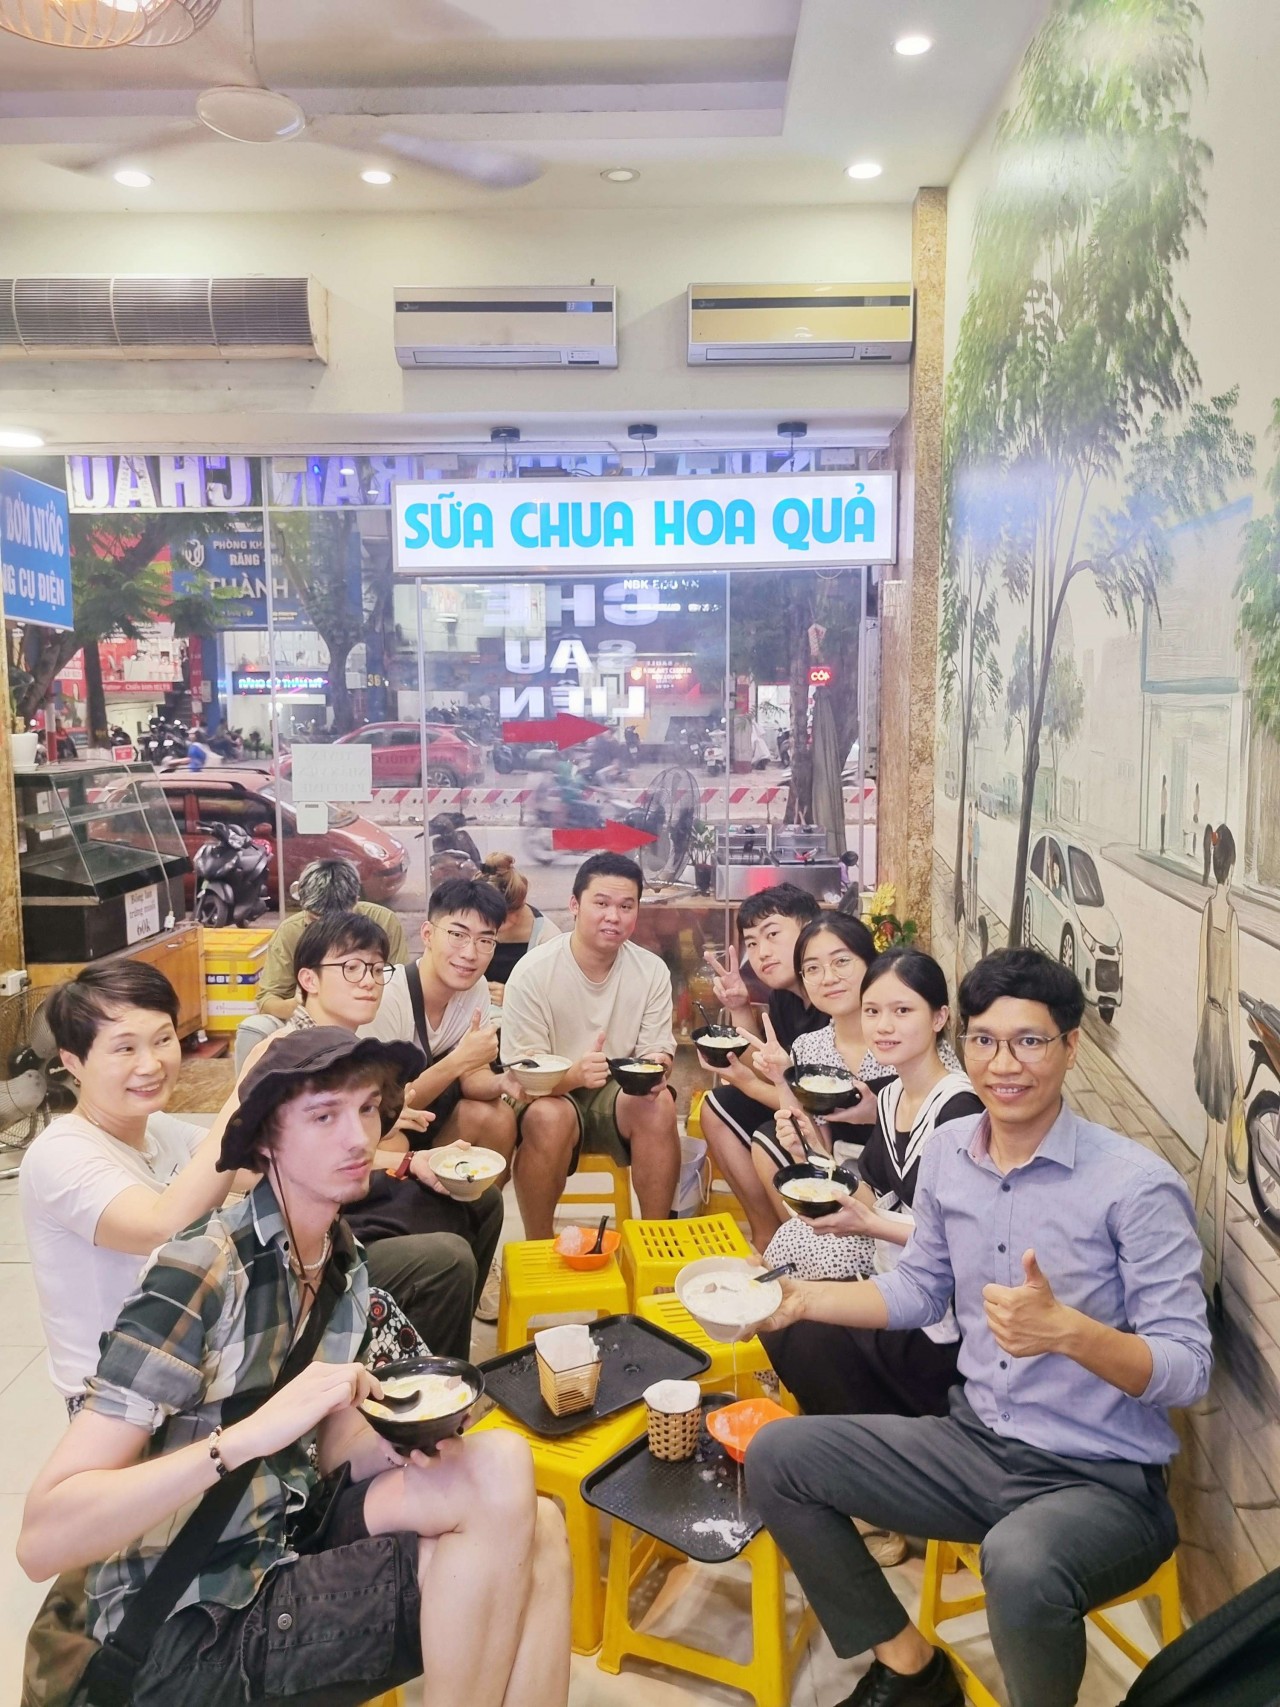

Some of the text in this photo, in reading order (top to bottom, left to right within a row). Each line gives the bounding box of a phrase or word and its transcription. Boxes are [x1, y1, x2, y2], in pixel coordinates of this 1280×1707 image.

[32, 500, 64, 558] NƯỚC
[404, 482, 875, 551] SỮA CHUA HOA QUẢ
[213, 538, 247, 550] PHÒNG
[230, 553, 260, 566] RĂNG
[18, 567, 35, 606] CỤ
[38, 570, 65, 611] ĐIỆN
[207, 572, 288, 599] THÀNH
[623, 579, 648, 590] NBK
